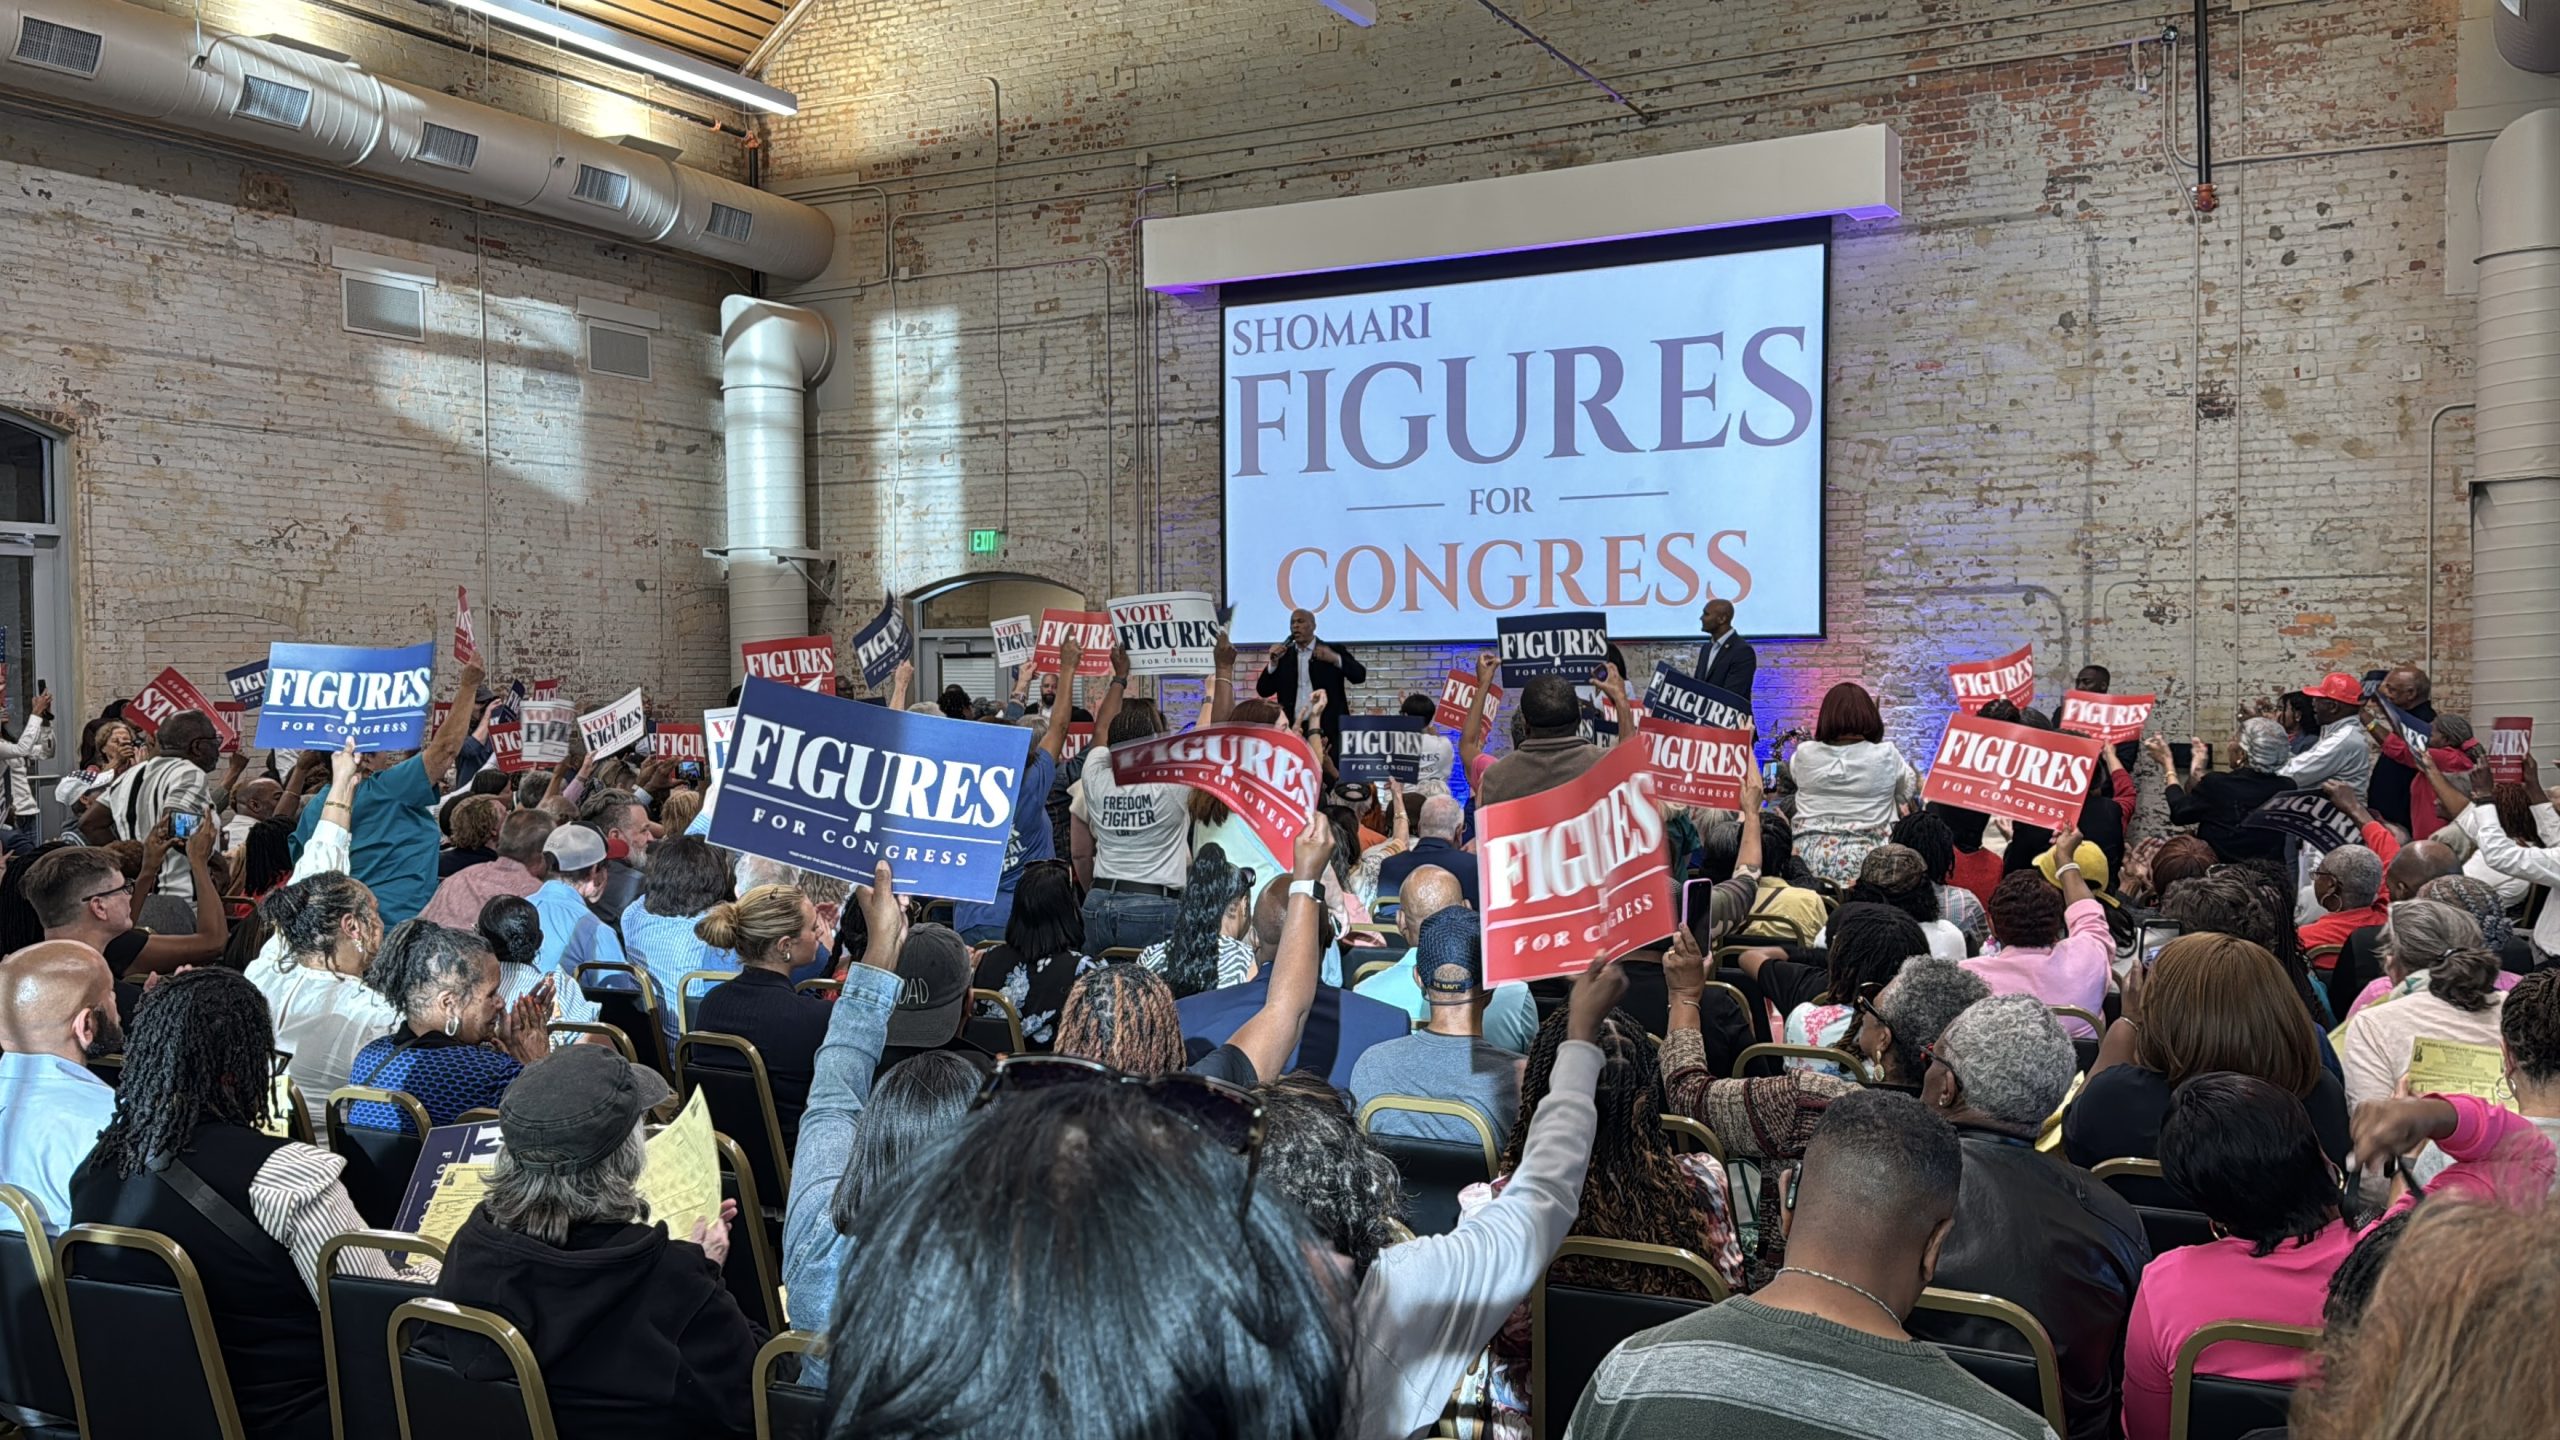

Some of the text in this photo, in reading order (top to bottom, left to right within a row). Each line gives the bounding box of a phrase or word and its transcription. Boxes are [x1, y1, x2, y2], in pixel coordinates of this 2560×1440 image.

[1232, 302, 1432, 356] SHOMARI
[1231, 326, 1813, 477] FIGURES
[1469, 486, 1534, 515] FOR
[974, 530, 995, 551] EXIT
[1276, 530, 1753, 614] CONGRESS
[1115, 604, 1173, 624] VOTE
[995, 623, 1023, 637] VOTE
[1038, 620, 1115, 650] FIGURE
[1117, 620, 1219, 651] FIGURES
[1500, 629, 1607, 660] FIGURES
[746, 647, 833, 678] FIGURES
[1141, 656, 1209, 665] FOR CONGRESS
[1951, 654, 2033, 697] FIGURES
[265, 667, 431, 711] FIGURES
[1442, 679, 1499, 722] FIGRES
[582, 709, 617, 733] VOTE
[1659, 682, 1748, 730] FIGURES
[2062, 698, 2152, 726] FIGURES
[281, 721, 408, 735] FOR CONGRESS
[586, 706, 642, 751] FIGURES
[1339, 730, 1422, 756] FIGURES
[728, 714, 1015, 828] FIGURES
[1117, 734, 1318, 815] FIGURES
[1937, 729, 2092, 795] FIGURES
[1103, 794, 1152, 810] FREEDOM
[1198, 771, 1293, 838] CONGRESS
[1670, 783, 1735, 798] CONGRESS
[1942, 780, 2065, 818] FOR CONGRESS
[1102, 810, 1156, 827] FIGHTER
[752, 807, 806, 836] FOR
[822, 829, 968, 867] CONGRESS
[1514, 930, 1571, 955] FOR
